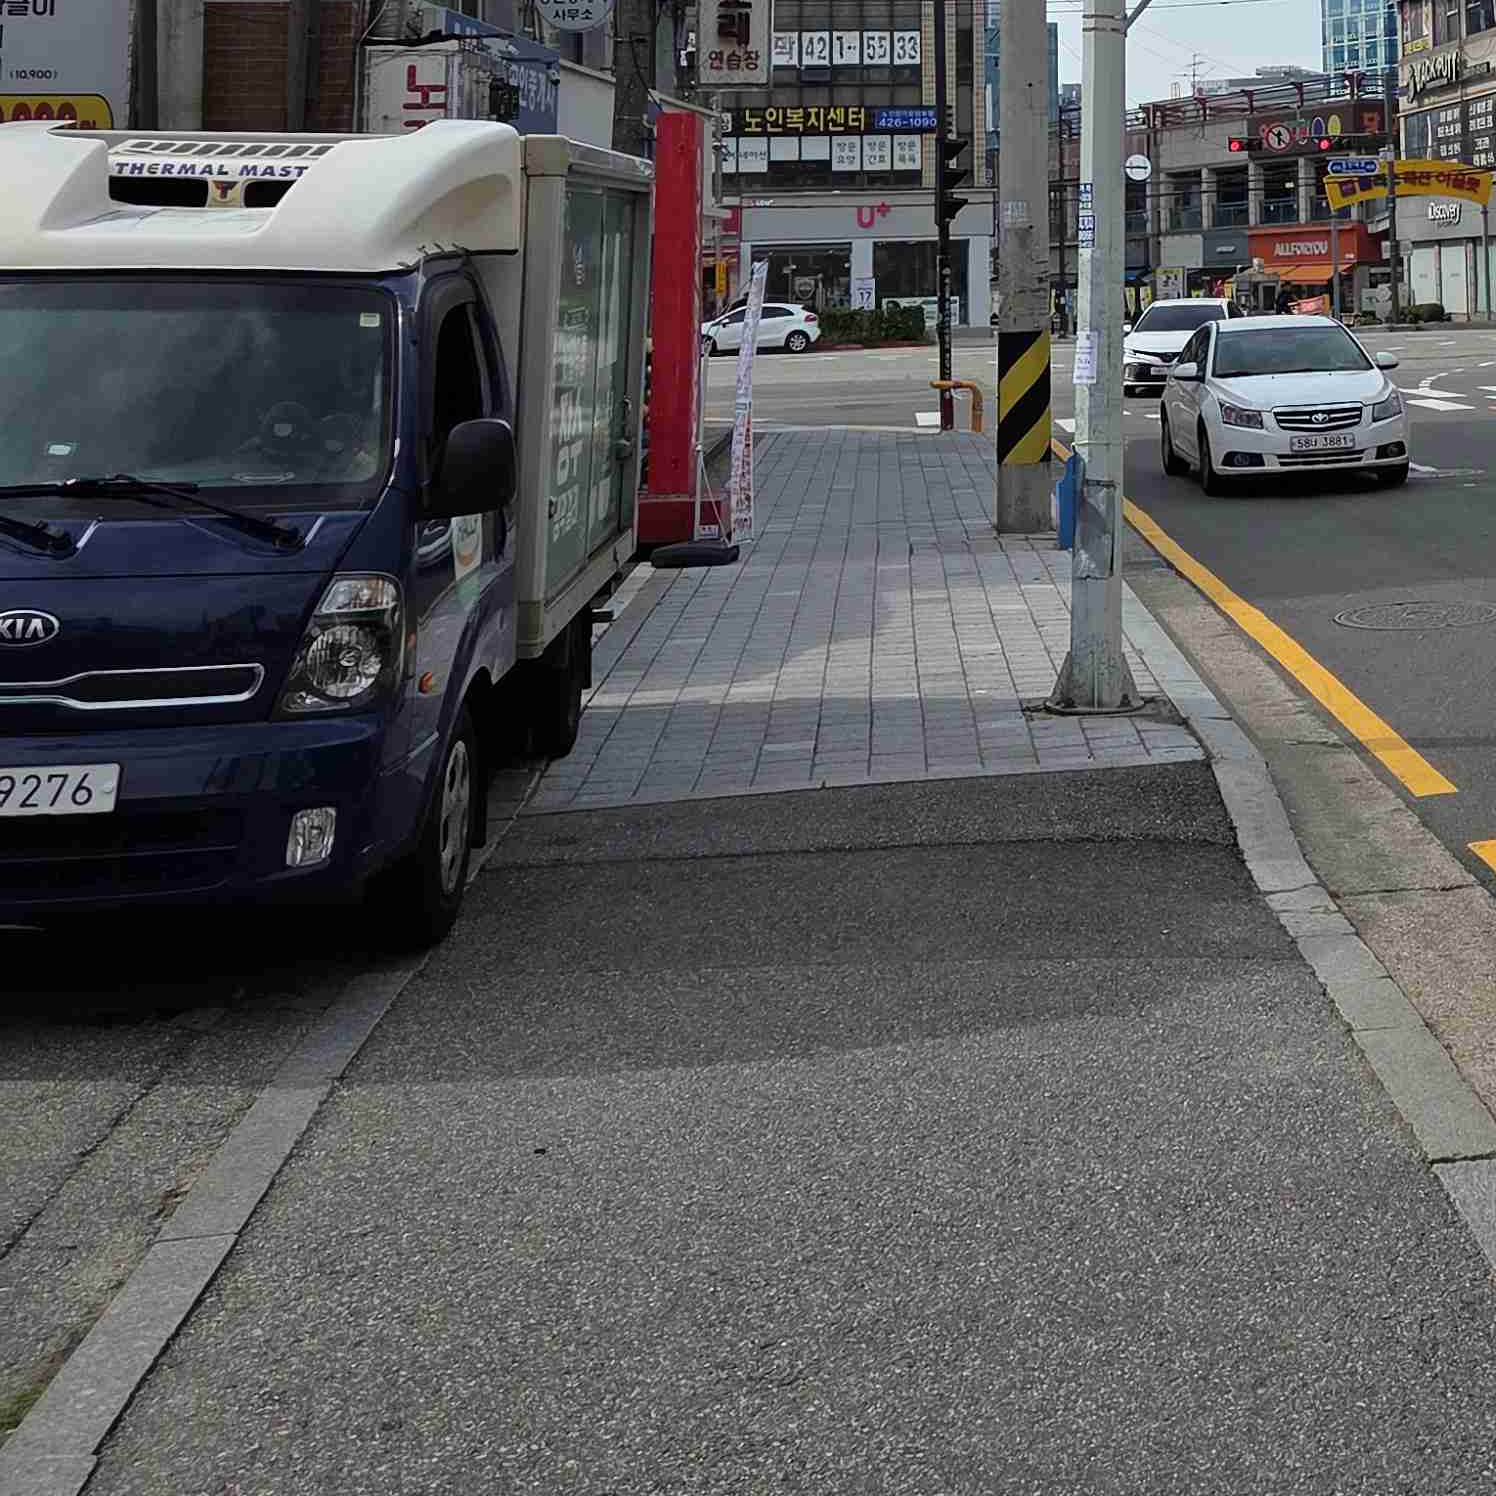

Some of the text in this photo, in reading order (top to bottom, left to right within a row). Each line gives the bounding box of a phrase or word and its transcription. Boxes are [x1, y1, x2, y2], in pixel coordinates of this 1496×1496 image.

[552, 8, 594, 21] 사무소
[708, 50, 760, 72] 연습장
[744, 106, 866, 133] 노인복지센터
[115, 161, 229, 176] THERMAL
[0, 772, 94, 809] 9276
